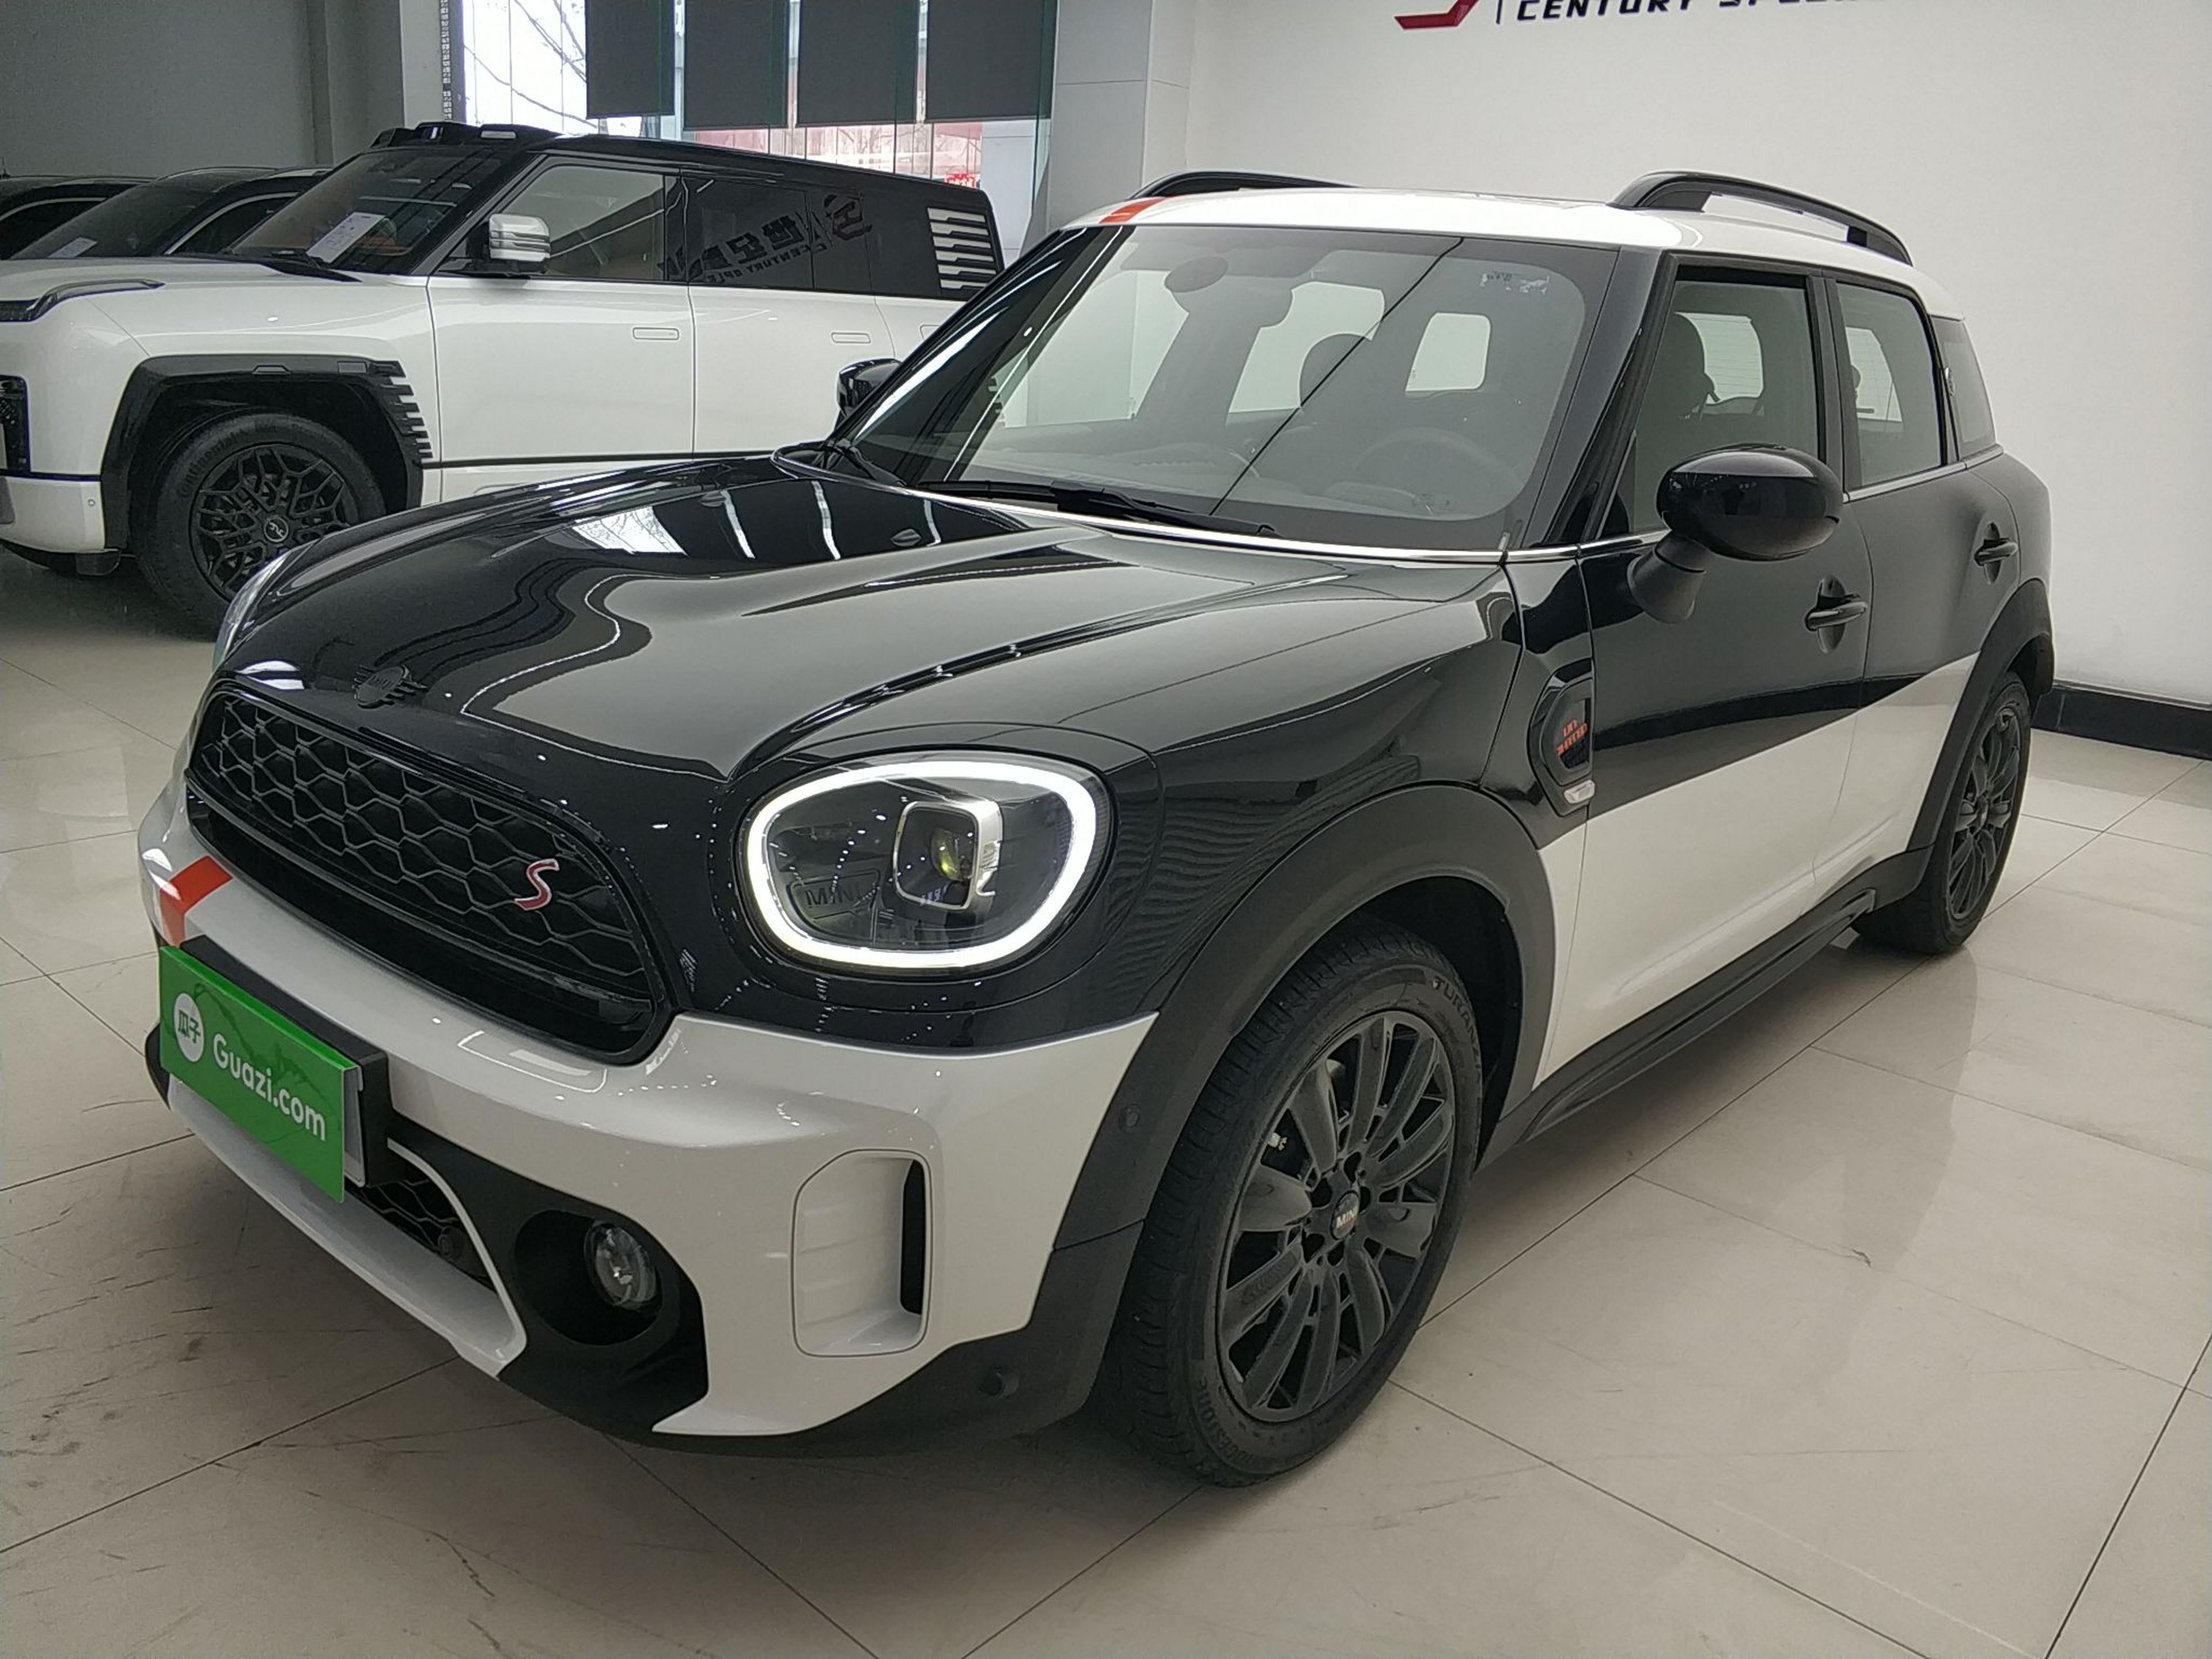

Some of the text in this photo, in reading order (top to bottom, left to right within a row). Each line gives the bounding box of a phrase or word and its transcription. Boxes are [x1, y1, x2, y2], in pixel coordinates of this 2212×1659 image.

[514, 858, 560, 911] S
[805, 884, 860, 906] MINI
[178, 1009, 326, 1141] 瓜子 Guazi.com
[1336, 1207, 1358, 1228] MINI
